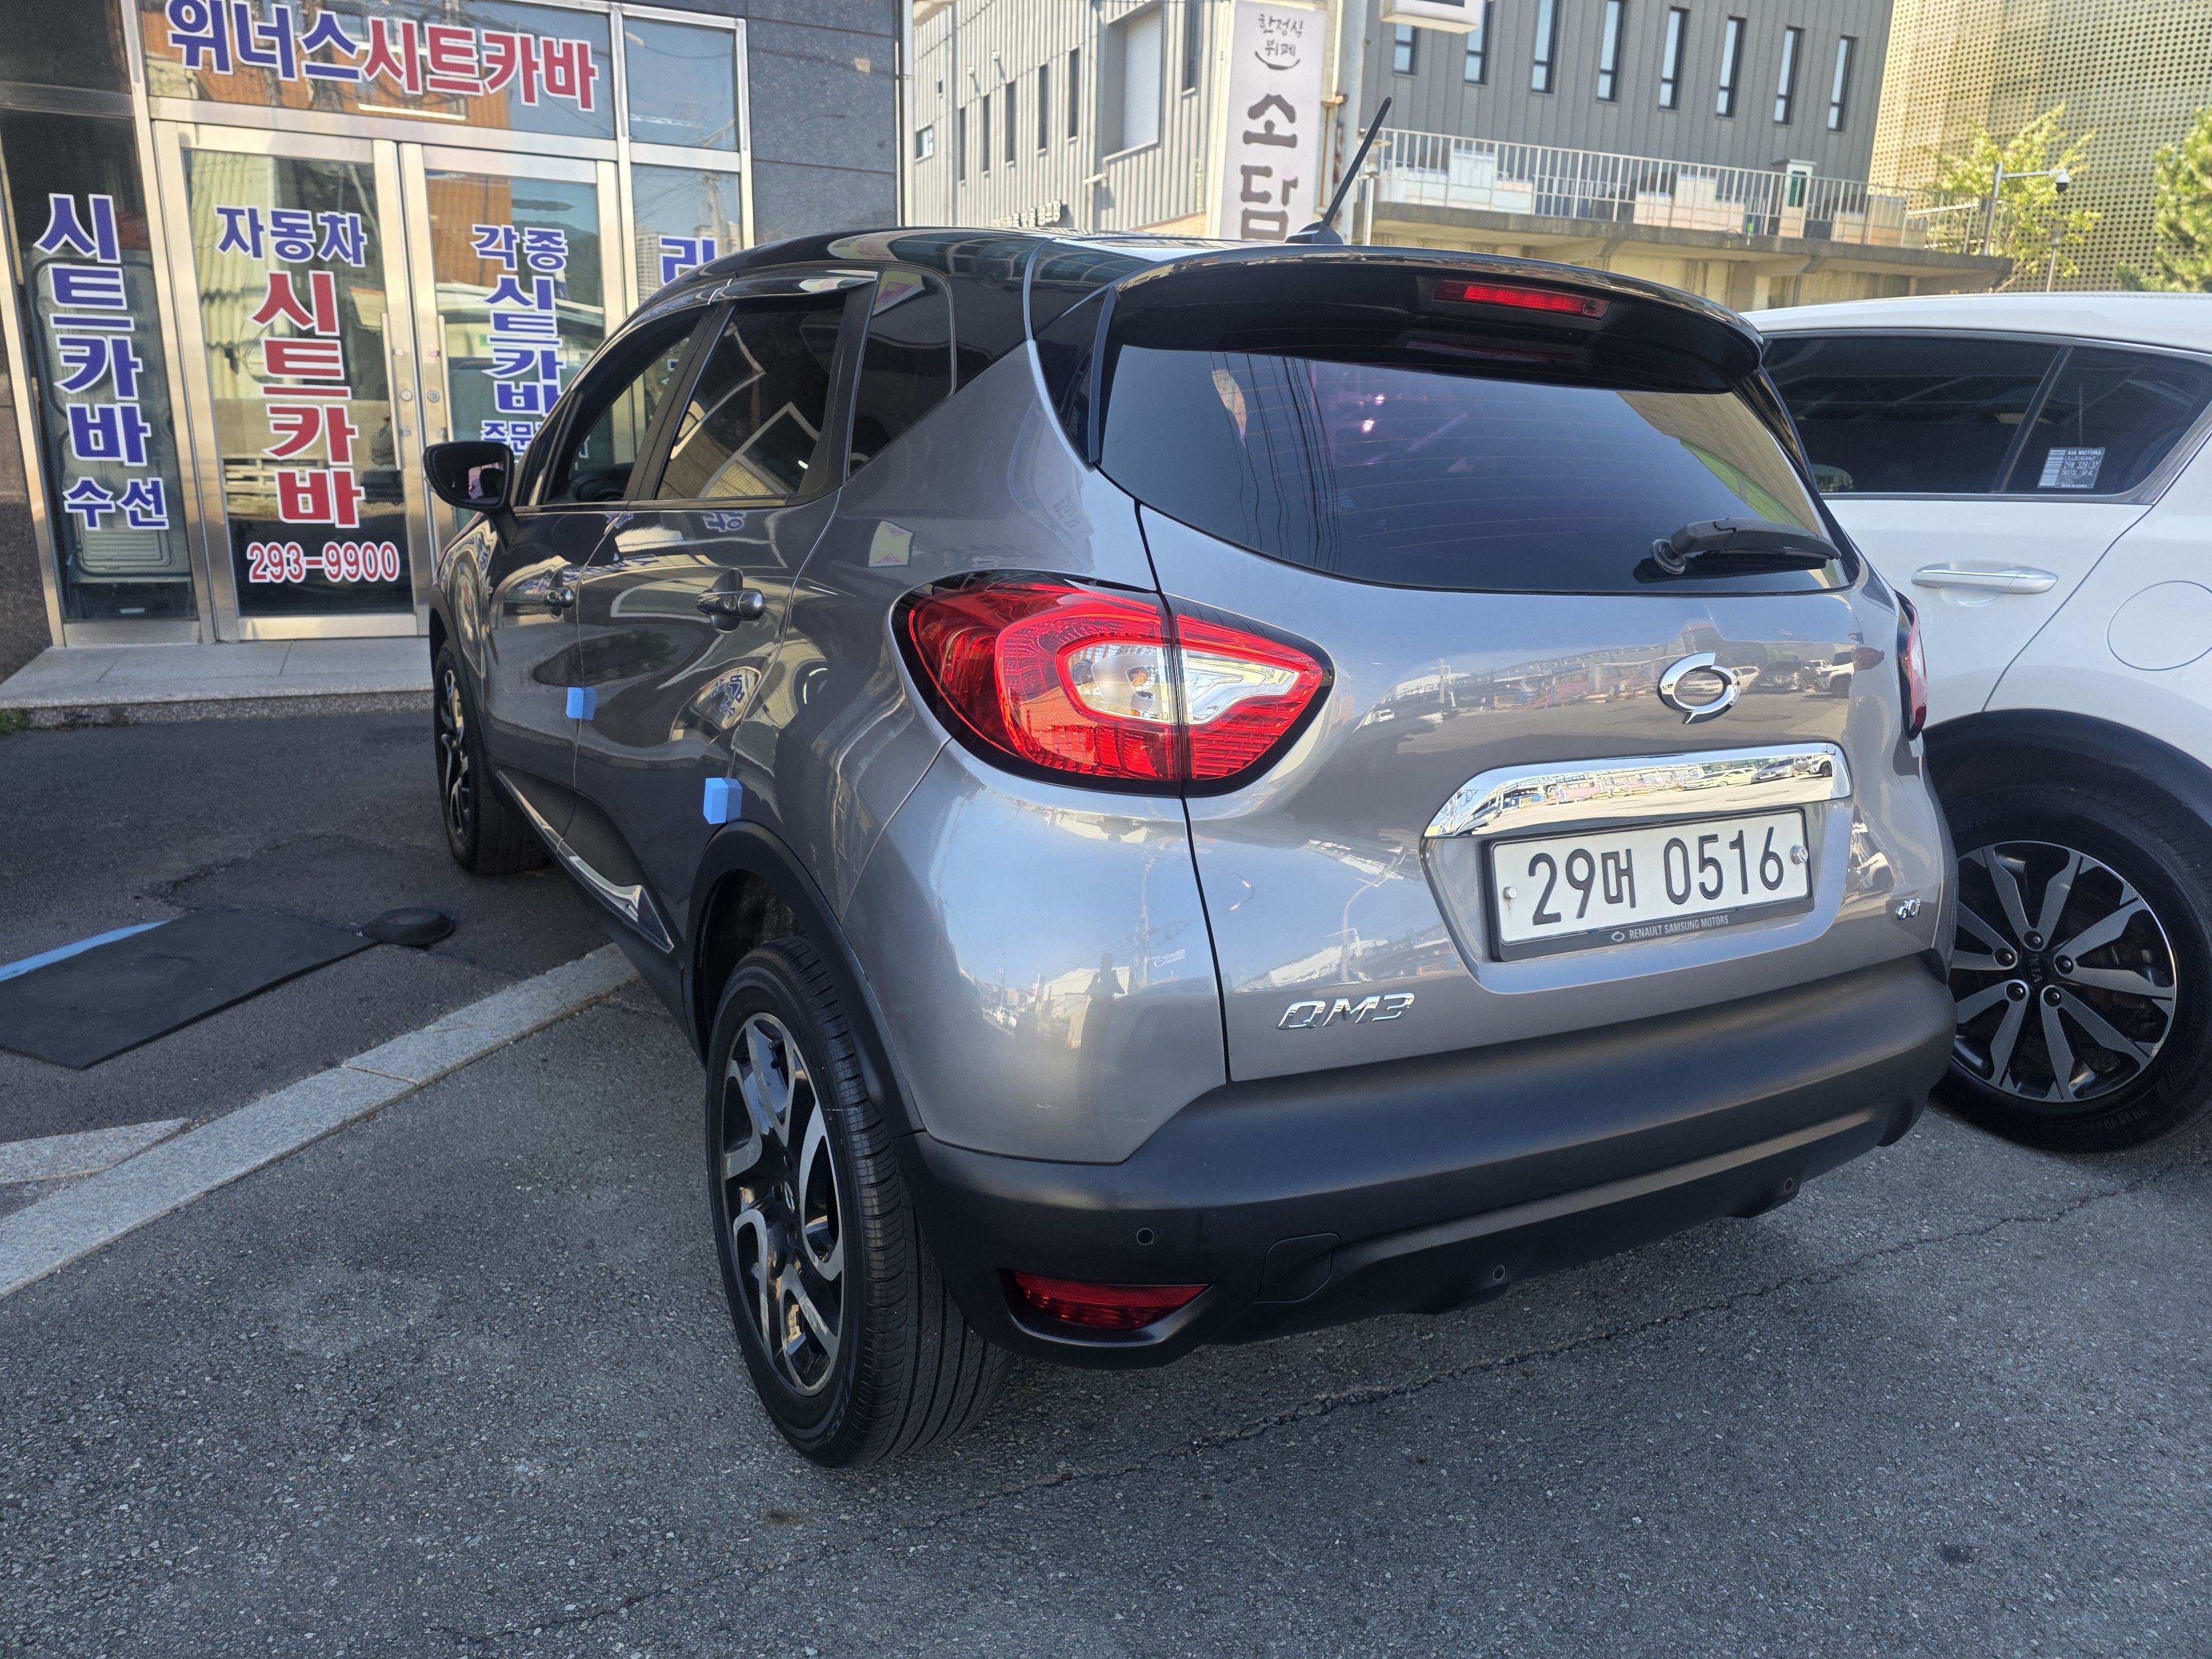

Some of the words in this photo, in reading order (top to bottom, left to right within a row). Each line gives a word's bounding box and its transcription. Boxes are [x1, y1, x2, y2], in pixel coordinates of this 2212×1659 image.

[1258, 13, 1304, 38] 한정식
[1265, 39, 1297, 57] 뷔페
[1240, 93, 1298, 241] 소담
[215, 205, 367, 267] 자동차
[471, 223, 568, 273] 각종
[34, 193, 151, 466] 시트카바
[248, 270, 365, 528] 시트카바
[62, 477, 169, 530] 수선
[247, 541, 400, 583] 293-9900
[1528, 848, 1636, 926] 29머
[1663, 826, 1784, 905] 0516
[1629, 925, 1662, 940] RENAULT
[1665, 920, 1699, 933] SAMSUNG
[1700, 914, 1729, 927] MOTORS
[1276, 992, 1415, 1030] QM3
